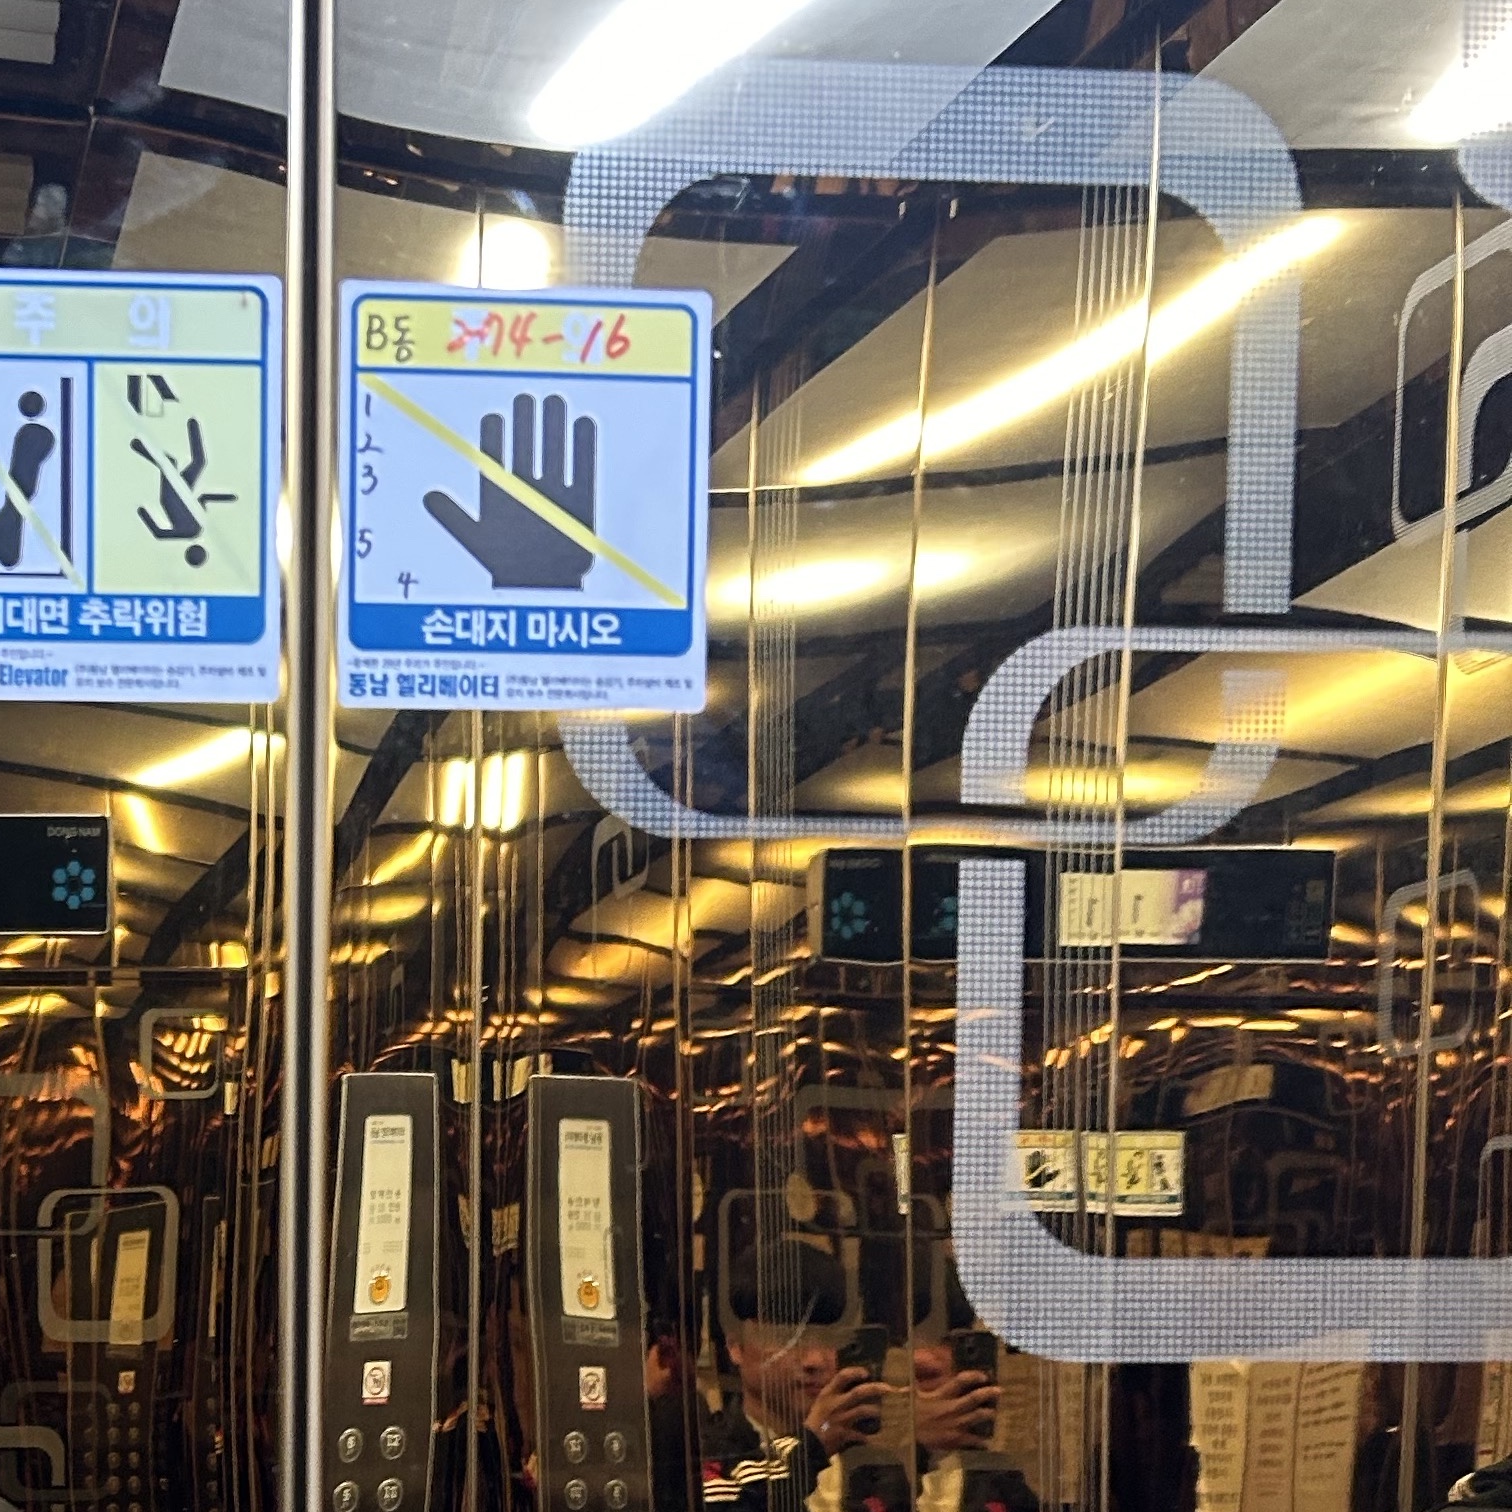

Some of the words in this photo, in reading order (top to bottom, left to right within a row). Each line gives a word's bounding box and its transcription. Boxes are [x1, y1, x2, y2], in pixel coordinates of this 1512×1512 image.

[365, 313, 416, 363] B동
[357, 432, 385, 454] 2
[360, 464, 379, 496] 3
[356, 528, 374, 560] 5
[397, 571, 419, 600] 4
[77, 598, 210, 638] 추락위험
[421, 610, 517, 649] 손대지
[527, 611, 622, 649] 마시오
[0, 663, 69, 688] Elevator
[348, 672, 390, 698] 동남
[396, 673, 500, 699] 엘리베이터
